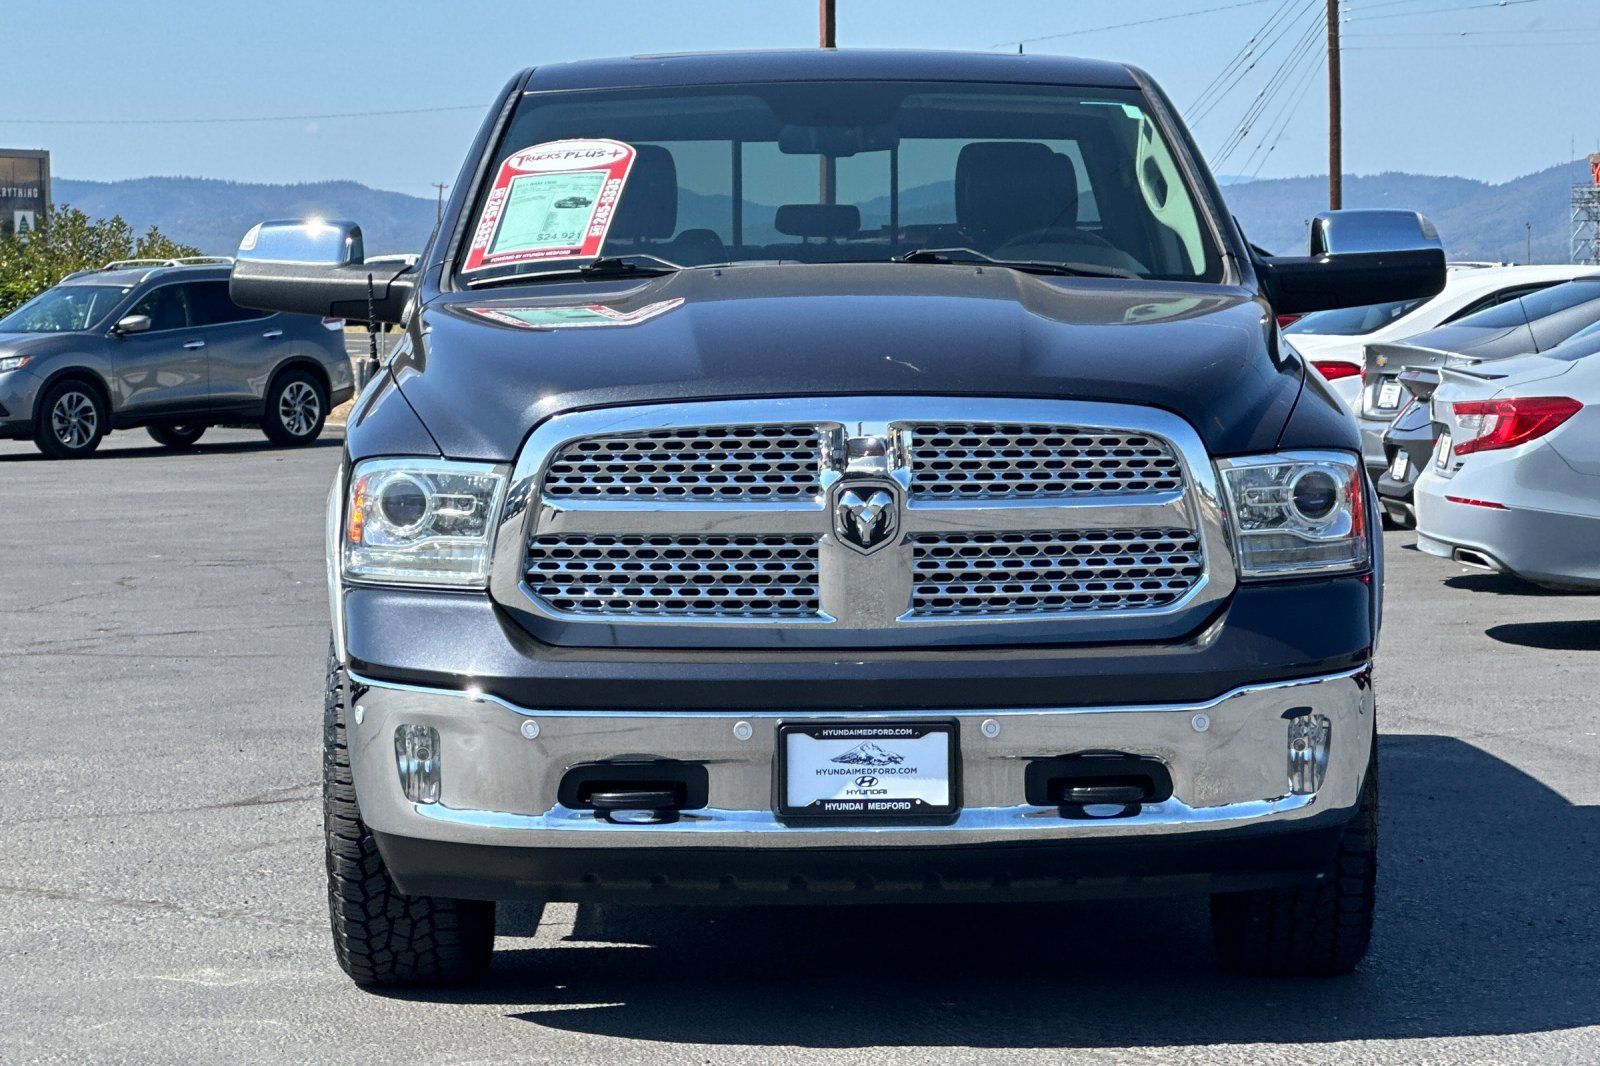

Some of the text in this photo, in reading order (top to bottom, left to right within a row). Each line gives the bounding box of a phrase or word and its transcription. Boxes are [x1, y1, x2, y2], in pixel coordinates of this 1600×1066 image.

[563, 150, 606, 159] PLUS
[0, 187, 38, 198] RYTHING
[822, 728, 913, 736] HYUNDAIMEDFORD.COM
[816, 767, 918, 775] HYUNDAIMEDFORD.COM
[846, 788, 888, 796] HYUNDAI
[825, 802, 911, 811] HYUNDAI MEDFORD
